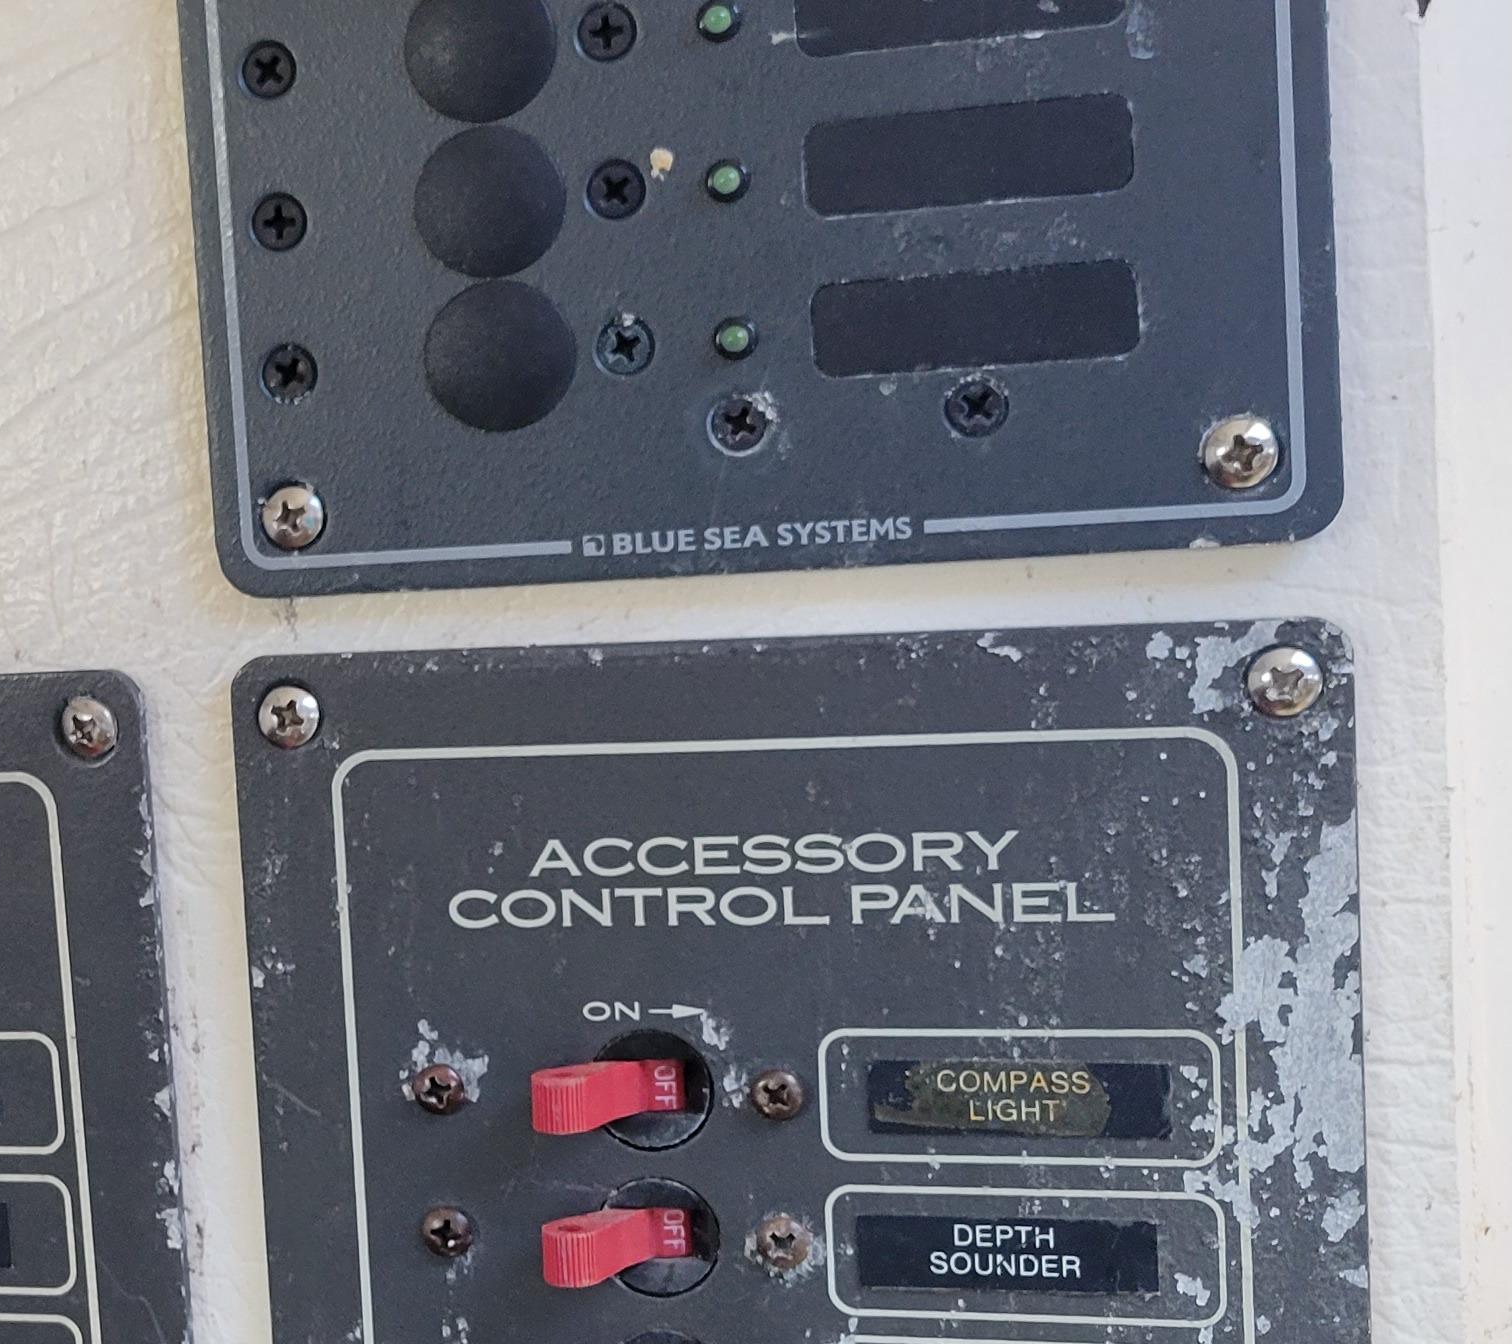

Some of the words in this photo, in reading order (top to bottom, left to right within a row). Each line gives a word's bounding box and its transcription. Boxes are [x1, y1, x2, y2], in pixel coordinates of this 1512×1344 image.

[612, 529, 696, 556] BLUE
[703, 524, 769, 551] SEA
[776, 516, 912, 547] SYSTEMS
[528, 829, 1020, 878] ACCESSORY
[448, 885, 831, 930] CONTROL
[850, 881, 1117, 927] PANEL
[581, 1000, 642, 1022] ON
[653, 1065, 677, 1110] OFF
[936, 1069, 1091, 1095] COMPASS
[968, 1098, 1060, 1123] LIGHT
[663, 1209, 686, 1257] OFF
[953, 1223, 1055, 1249] DEPTH
[929, 1251, 1081, 1278] SOUNDER
